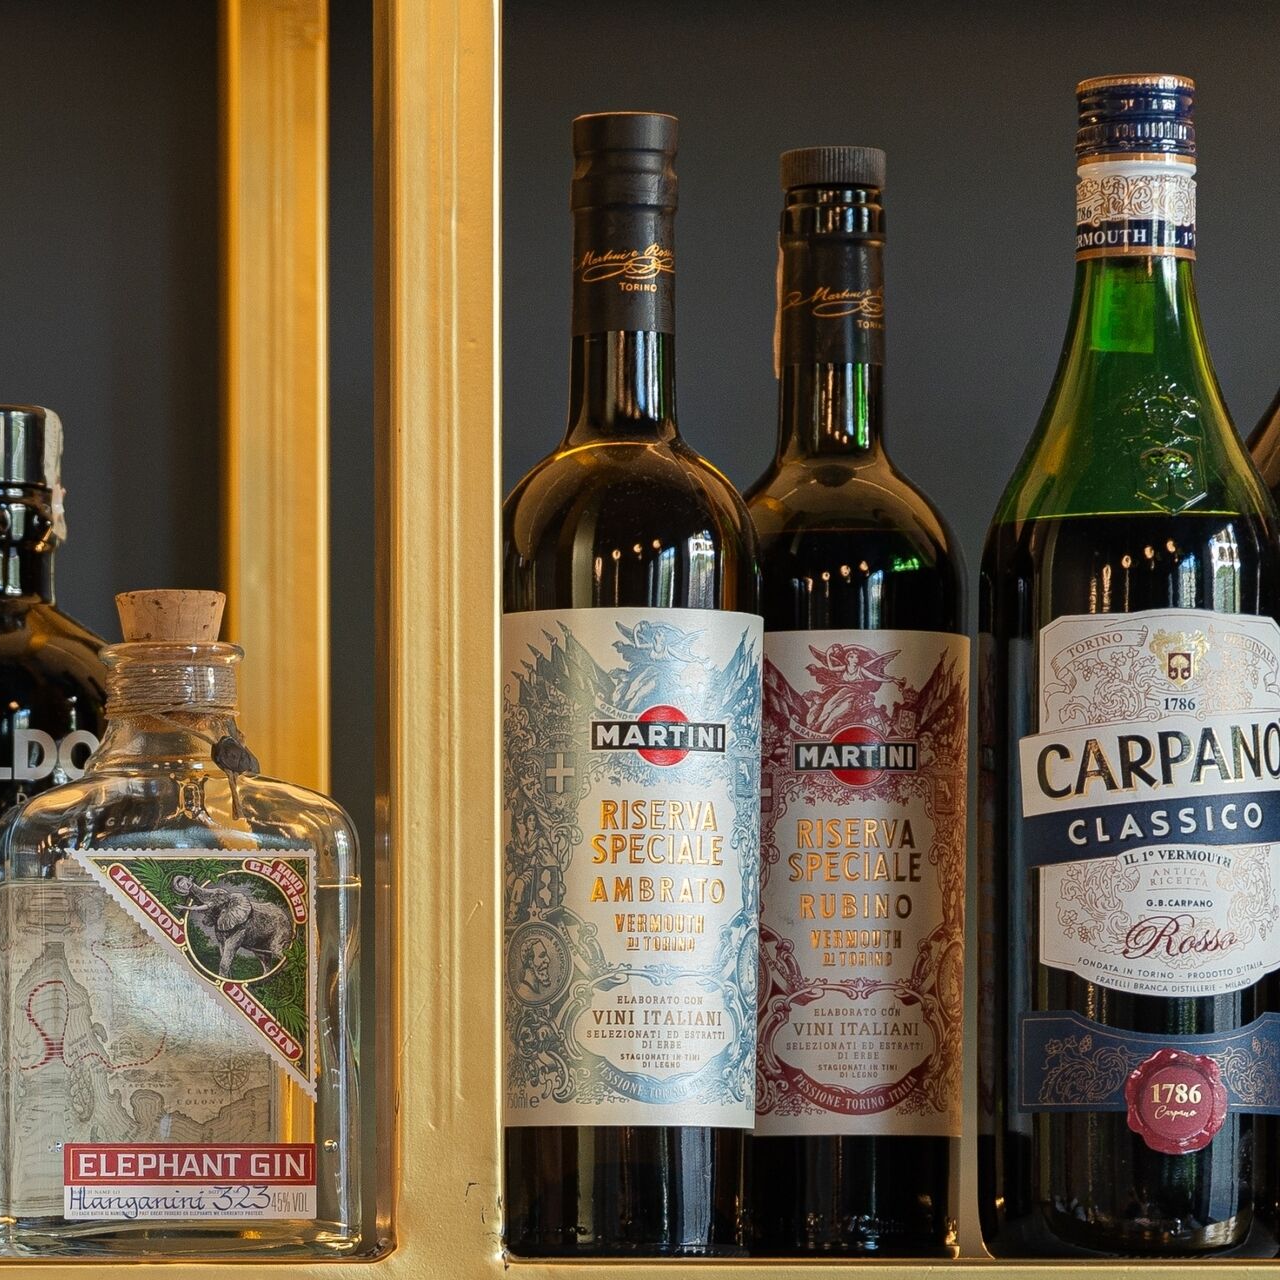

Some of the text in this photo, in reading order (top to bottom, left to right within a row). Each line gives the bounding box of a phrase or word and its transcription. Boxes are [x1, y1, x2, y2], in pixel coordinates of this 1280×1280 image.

[619, 282, 658, 293] TORINO
[1066, 632, 1123, 657] TORINO
[1163, 697, 1196, 711] 1786
[596, 724, 724, 749] MARTINI
[799, 745, 914, 768] MARTINI
[1036, 721, 1280, 799] CARPANO
[599, 799, 718, 832] RISERVA
[1068, 802, 1263, 845] CLASSICO
[797, 818, 916, 849] RISERVA
[591, 834, 724, 866] SPECIALE
[1157, 849, 1232, 868] VERMOUTH
[274, 861, 304, 892] HAND
[788, 851, 922, 882] SPECIALE
[1152, 867, 1207, 878] ANTICA
[248, 859, 306, 921] CRAFTED
[590, 876, 725, 904] AMBRATO
[1149, 877, 1209, 887] RICETTA
[111, 865, 185, 942] LONDON
[799, 894, 913, 920] RUBINO
[614, 913, 705, 933] VERMOUTH
[643, 936, 696, 952] TORINO
[810, 929, 902, 949] VERMOUTH
[1122, 914, 1239, 960] Rosso
[839, 951, 893, 968] TORINO
[1077, 956, 1119, 974] FONDATA
[1138, 969, 1175, 980] TORINO
[1187, 969, 1233, 980] PRODOTTO
[1095, 975, 1216, 993] FRATELLI BRANCA DISTILLERIE
[616, 995, 704, 1005] ELABORATO CON
[226, 983, 300, 1058] DRY GIN
[592, 1010, 722, 1026] VINI ITALIANI
[814, 1007, 901, 1017] ELABORATO CON
[586, 1030, 726, 1040] SELEZIONATI ESTRATTI
[793, 1022, 920, 1037] VINI ITALIANI
[657, 1040, 682, 1049] ERBE
[786, 1042, 924, 1051] SELEZIONATI ESTRATTI
[620, 1053, 670, 1061] STAGIONATI
[853, 1051, 880, 1060] ERBE
[818, 1064, 867, 1072] STAGIONATI
[1150, 1083, 1202, 1105] 1786
[78, 1153, 306, 1178] ELEPHANT GIN
[212, 1184, 272, 1211] 323
[292, 1192, 310, 1212] VOL
